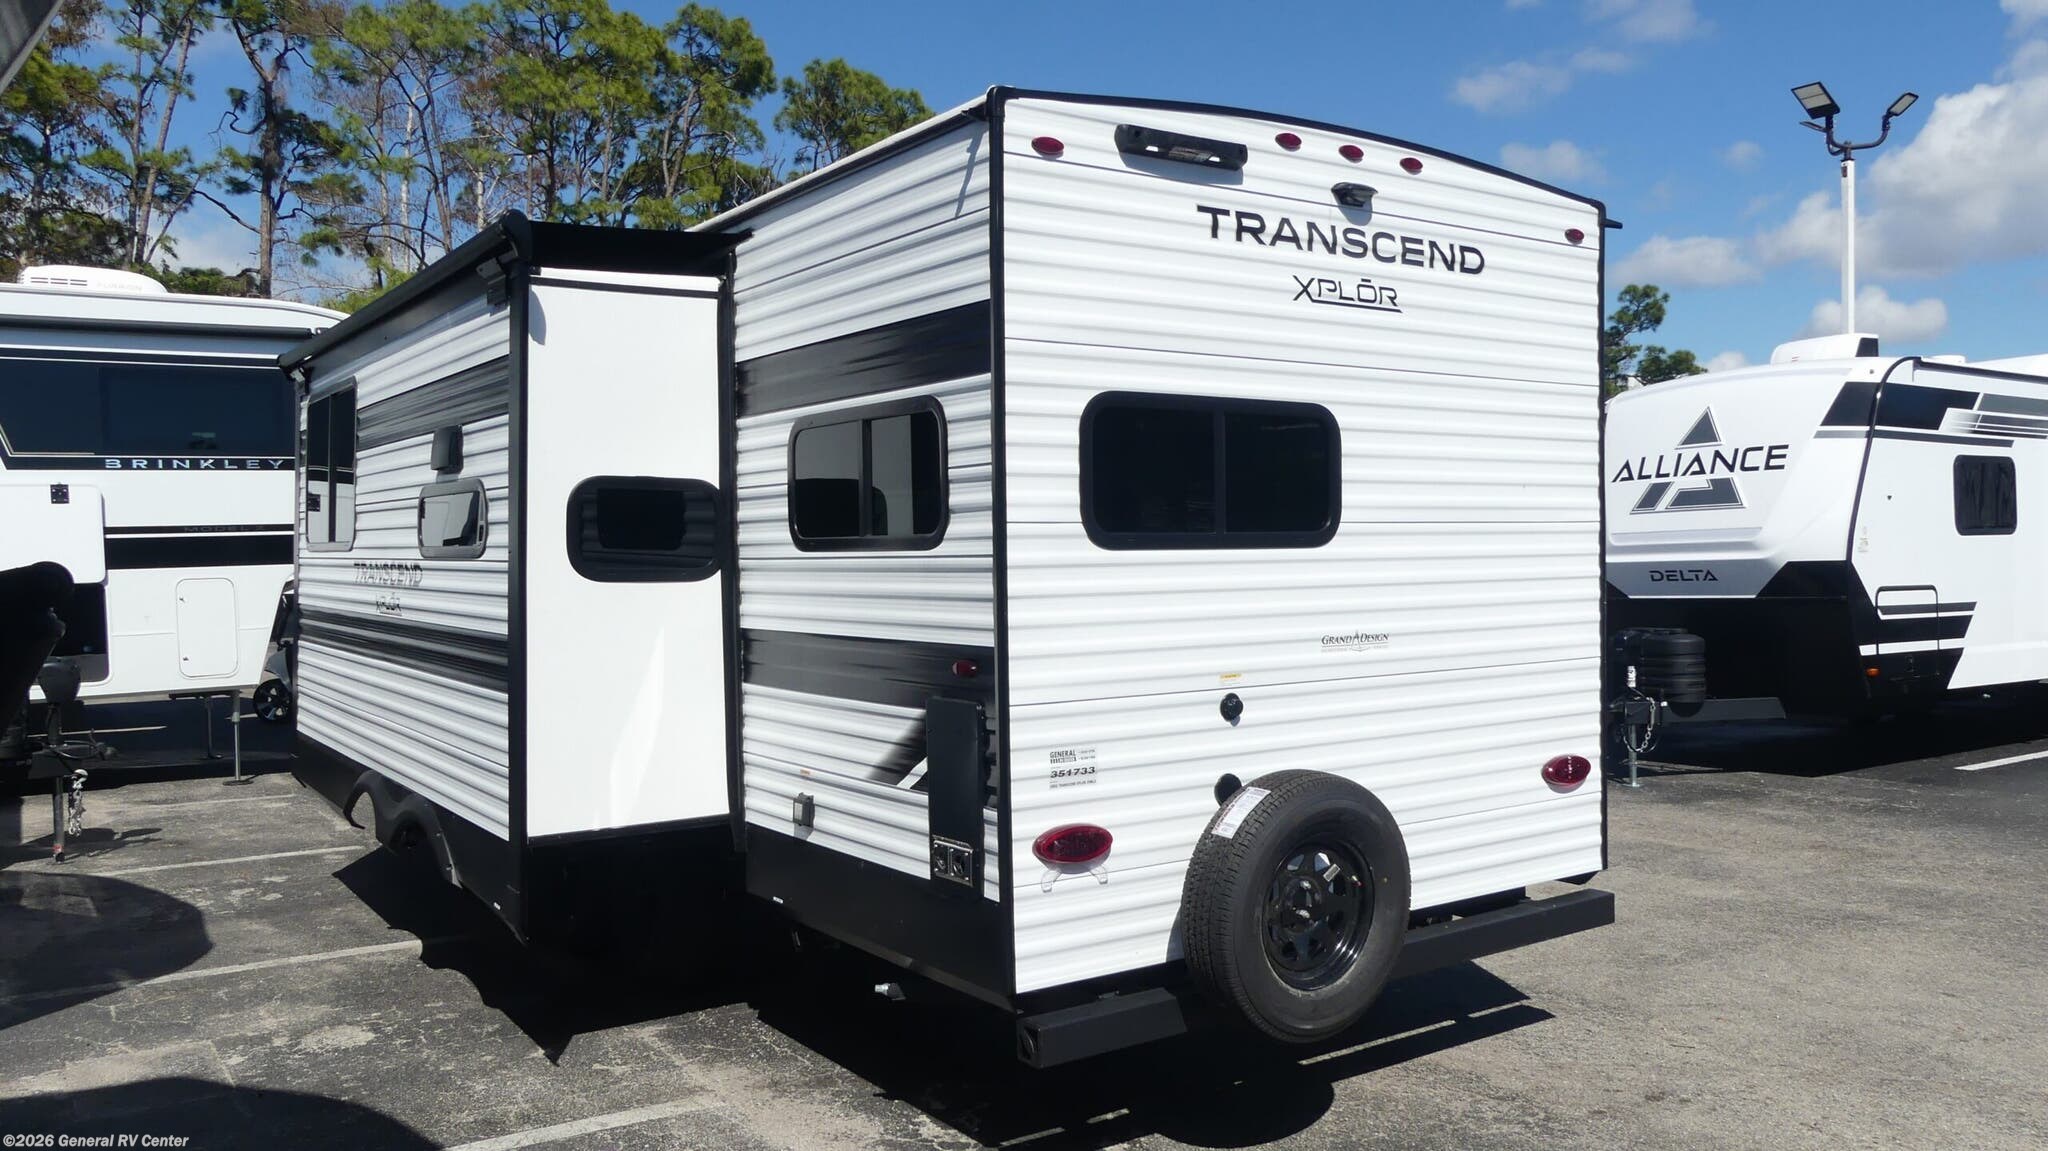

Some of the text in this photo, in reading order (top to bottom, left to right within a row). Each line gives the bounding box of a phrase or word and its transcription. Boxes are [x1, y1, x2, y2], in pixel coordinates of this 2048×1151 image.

[1196, 204, 1486, 275] TRANSCEND
[104, 458, 285, 469] BRINKLEY
[1611, 443, 1790, 483] ALLIANCE
[353, 562, 423, 587] TRANSCEND
[1649, 569, 1719, 582] DELTA
[1050, 766, 1096, 779] 351733
